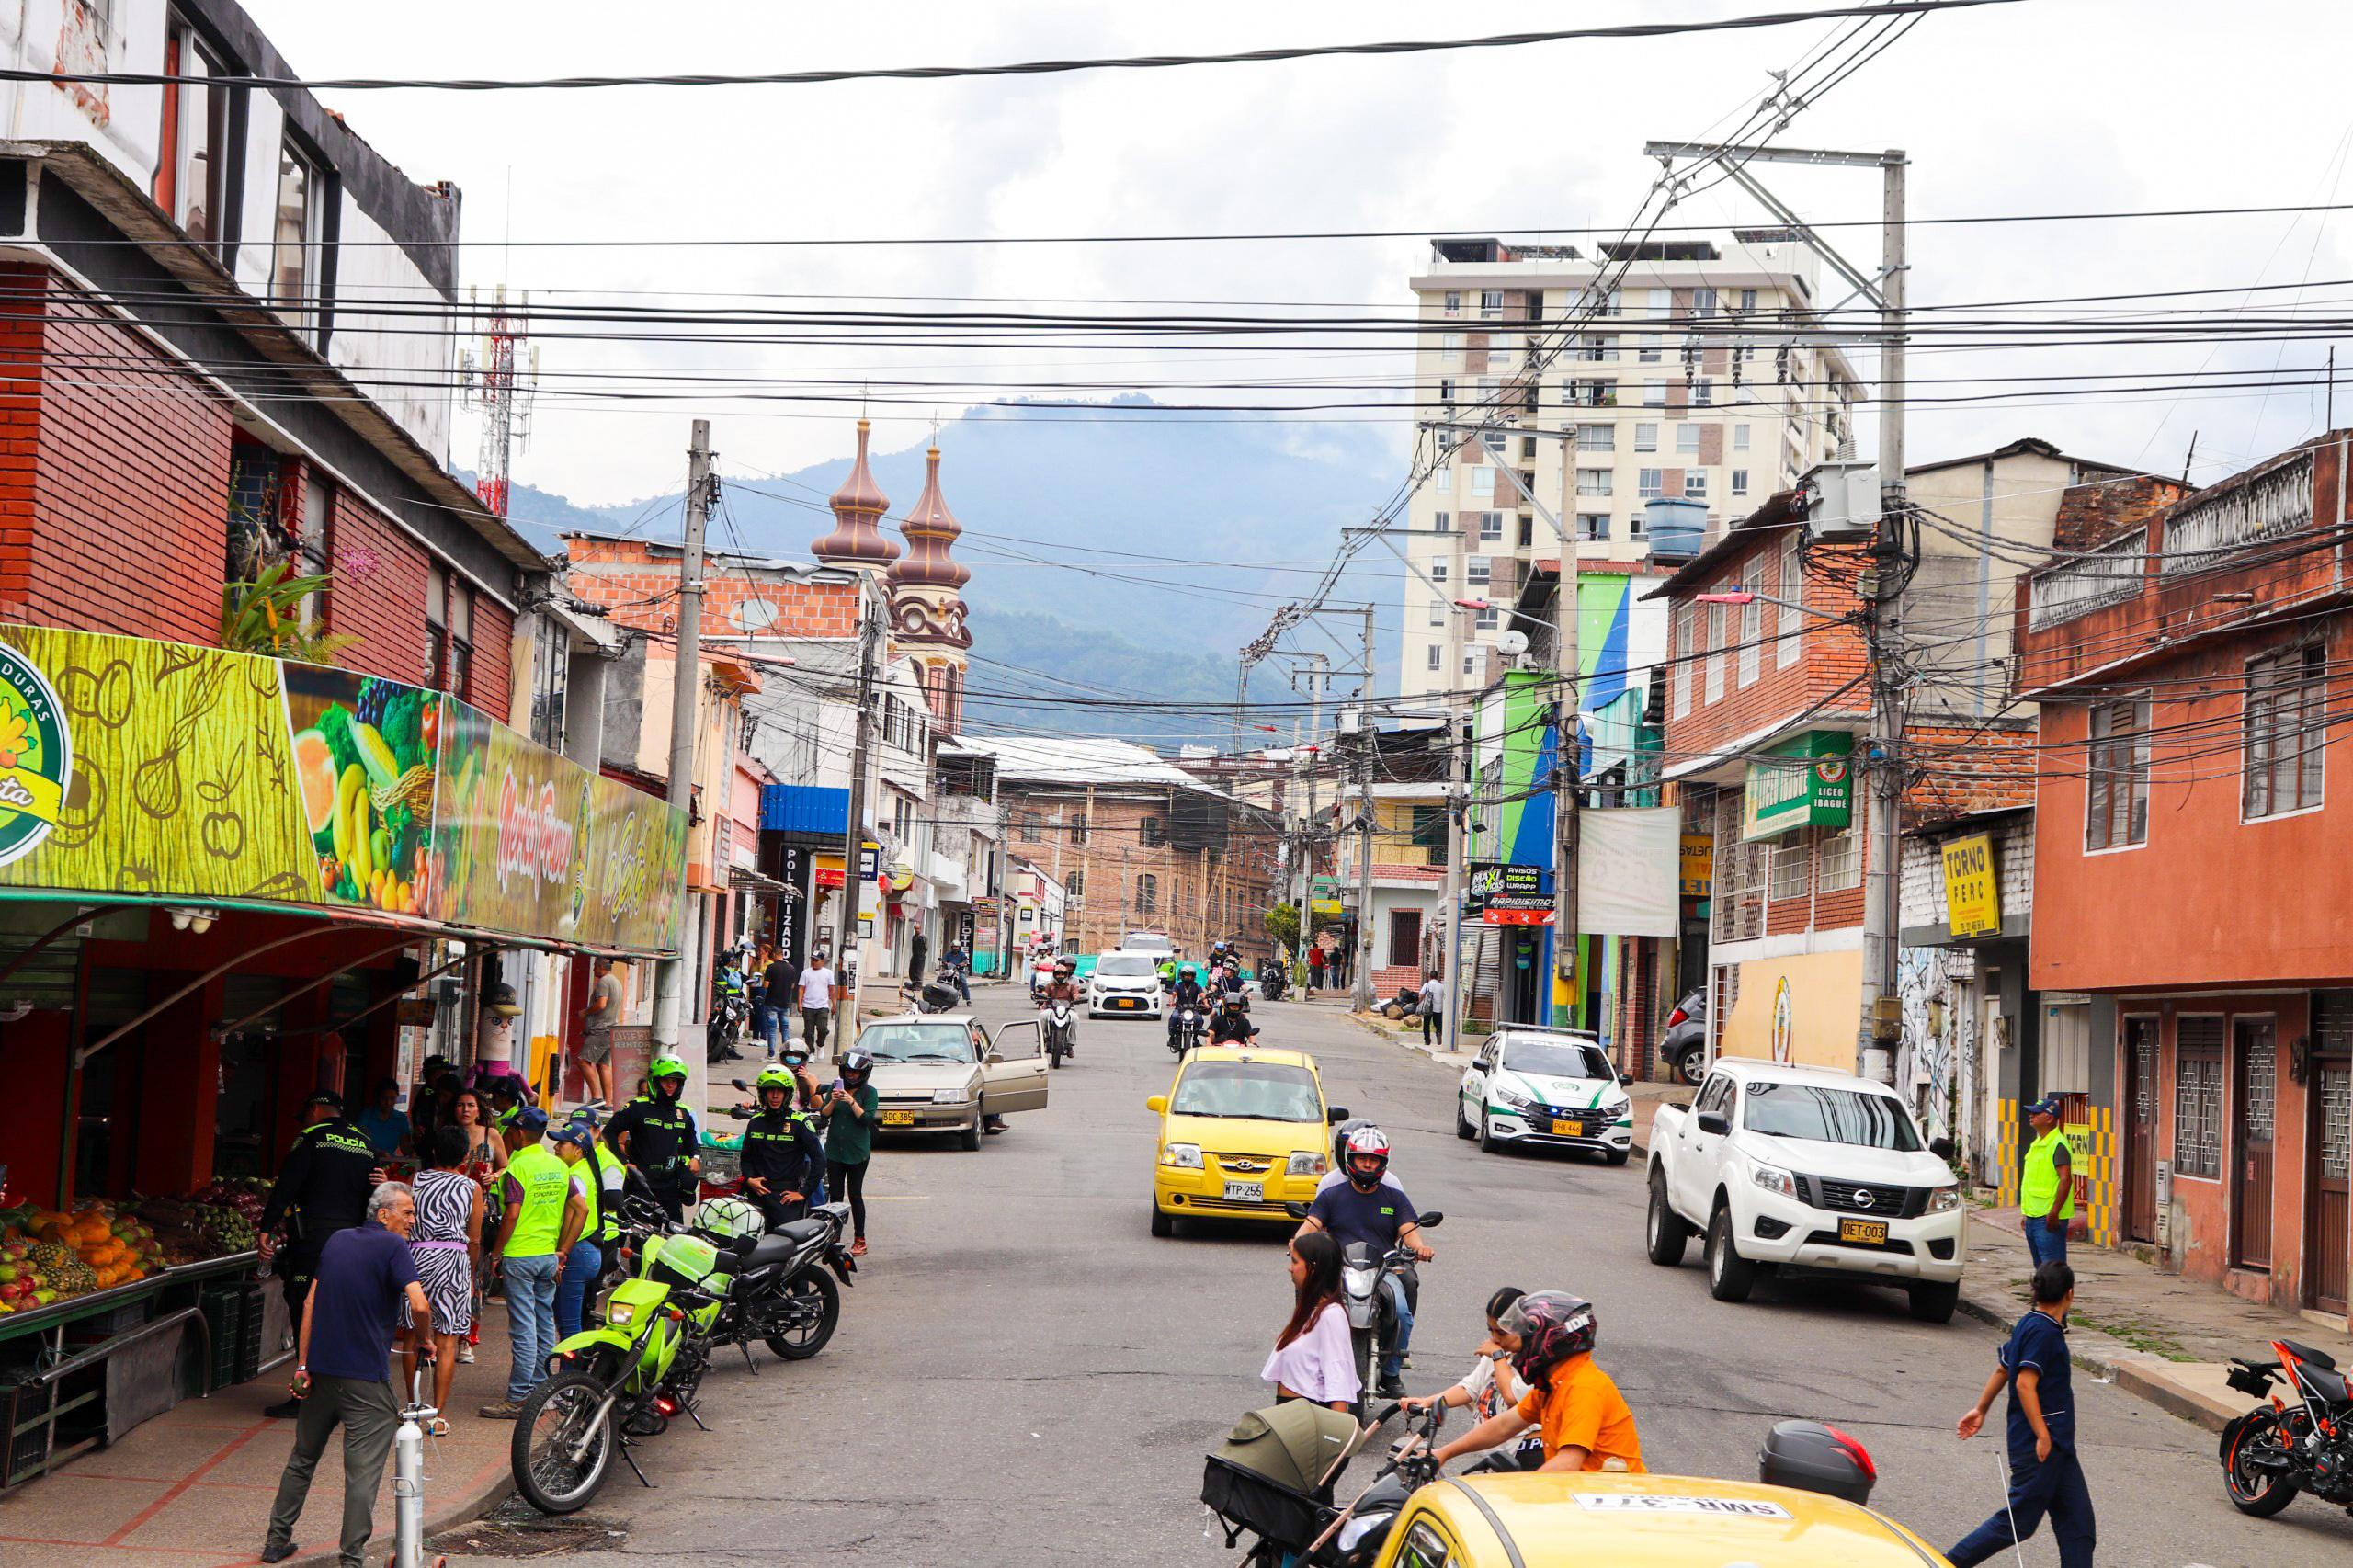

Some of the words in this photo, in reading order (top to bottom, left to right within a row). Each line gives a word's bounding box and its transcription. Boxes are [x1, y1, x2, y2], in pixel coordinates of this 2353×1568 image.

[1818, 787, 1844, 797] LICEO
[1946, 846, 1985, 880] TORNO
[1472, 866, 1501, 886] MAXI
[1507, 867, 1538, 875] AVISOS
[1506, 874, 1537, 882] DISEÑO
[1954, 881, 1984, 904] FERC
[1490, 897, 1552, 906] RAPIDISIMO
